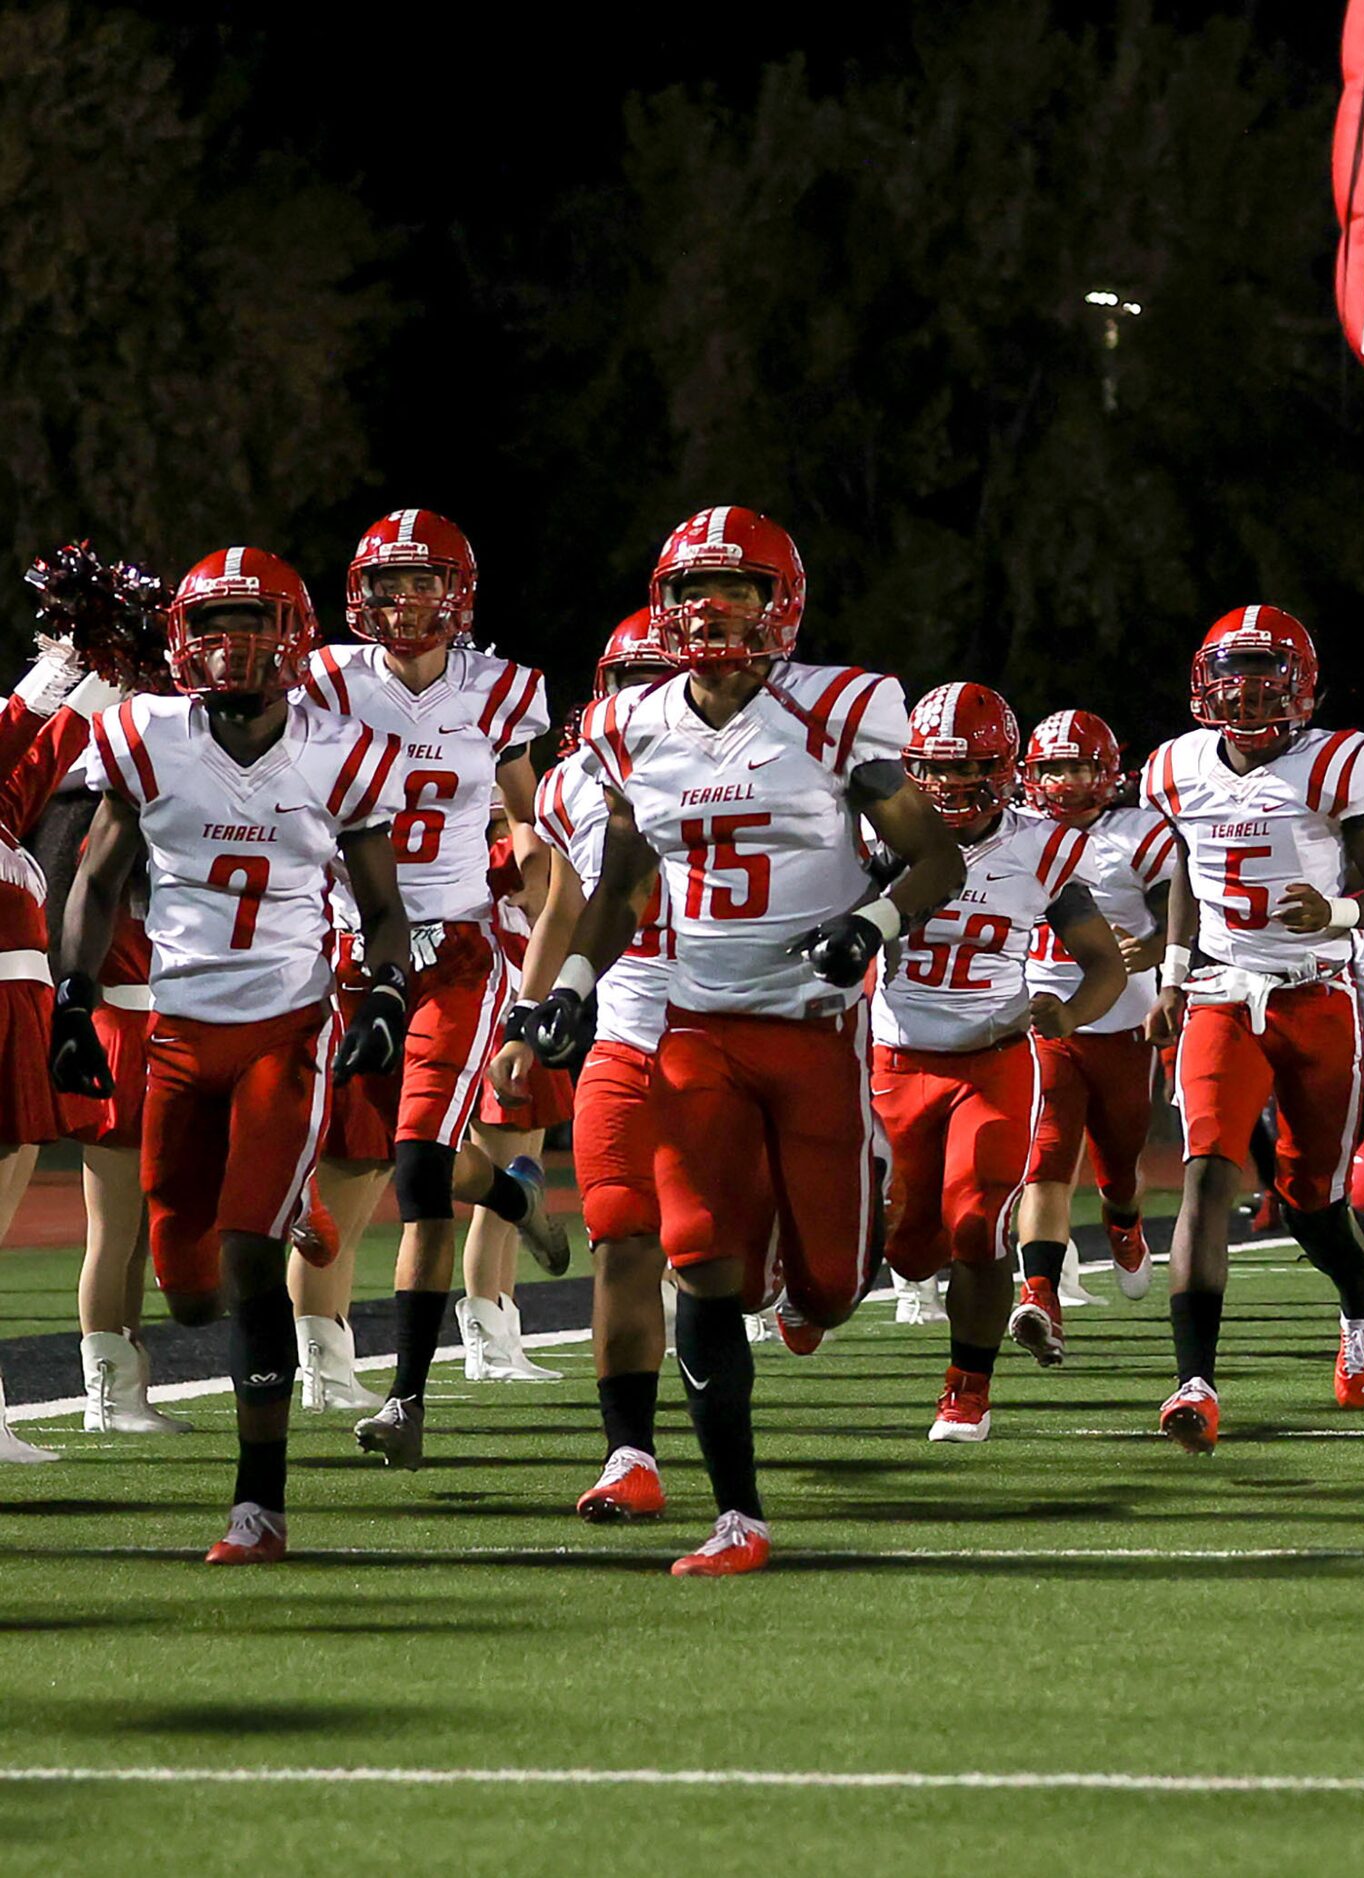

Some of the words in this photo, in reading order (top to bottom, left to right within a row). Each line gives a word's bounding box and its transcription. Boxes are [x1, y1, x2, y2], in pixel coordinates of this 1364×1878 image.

[407, 743, 443, 760] RELL
[201, 823, 279, 843] TERRELL
[390, 770, 459, 864] 6
[680, 783, 755, 807] TERRELL
[1211, 821, 1270, 839] TERRELL
[208, 854, 272, 950] 7
[679, 812, 772, 921] 15
[1223, 845, 1272, 931] 5
[905, 909, 1013, 990] 52
